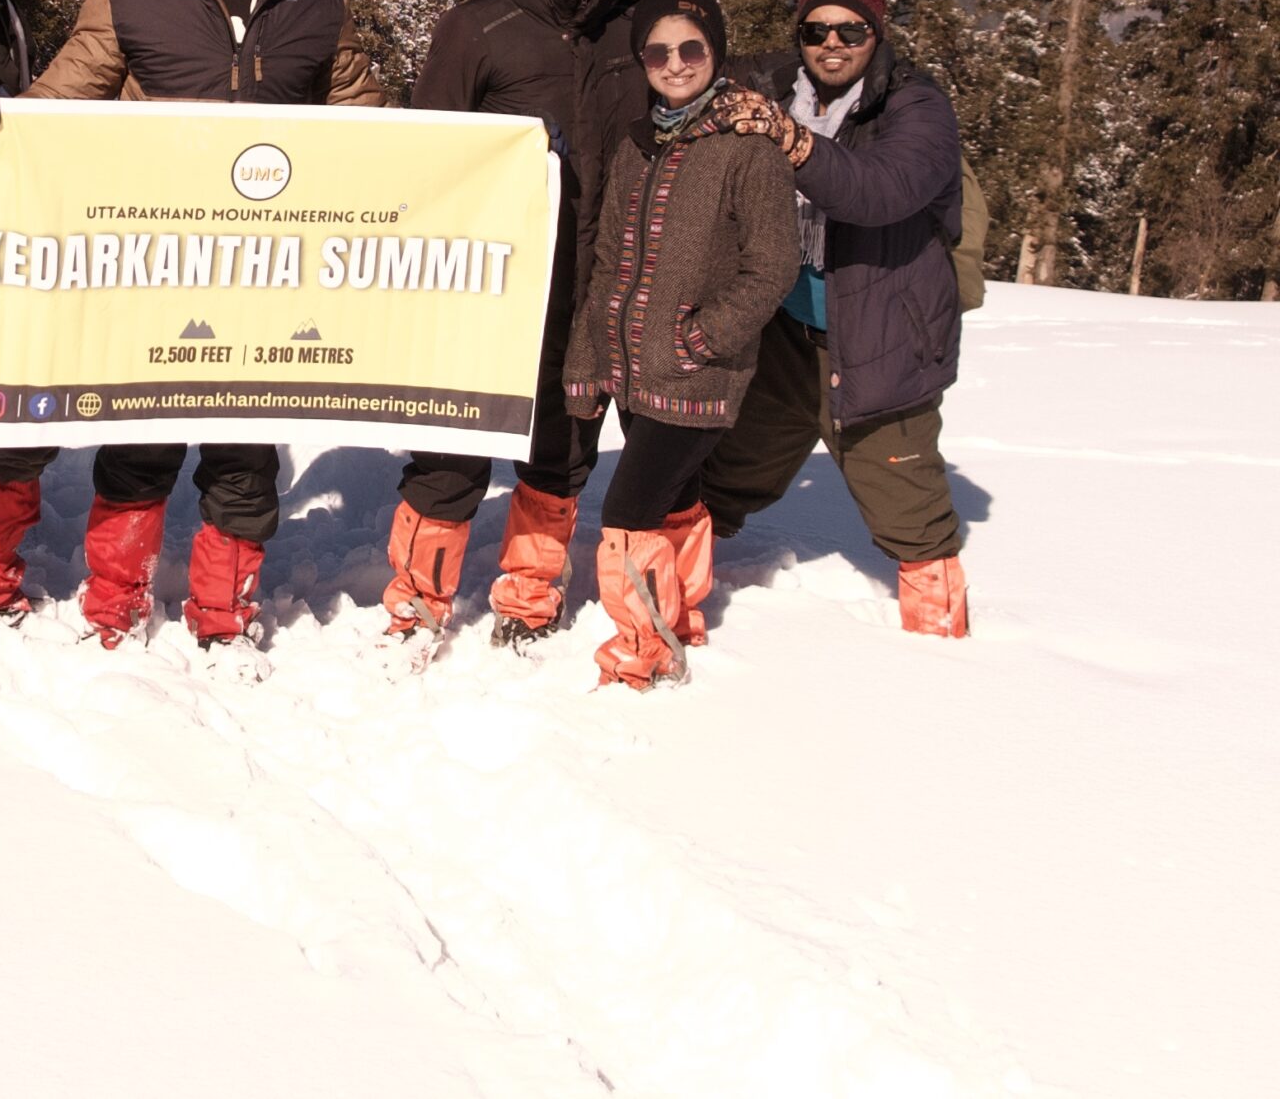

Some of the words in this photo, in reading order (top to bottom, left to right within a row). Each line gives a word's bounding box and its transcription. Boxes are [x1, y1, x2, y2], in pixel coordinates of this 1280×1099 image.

[240, 166, 285, 182] UMC
[86, 206, 206, 221] UTTARAKHAND
[211, 208, 355, 223] MOUNTAINEERING
[360, 210, 399, 223] CLUB
[318, 236, 513, 295] SUMMIT
[148, 346, 197, 364] 12,500
[200, 346, 233, 363] FEET
[254, 346, 294, 364] 3,810
[297, 347, 354, 364] METRES
[111, 391, 481, 420] www.uttarakhandmountaineeringclub.in
